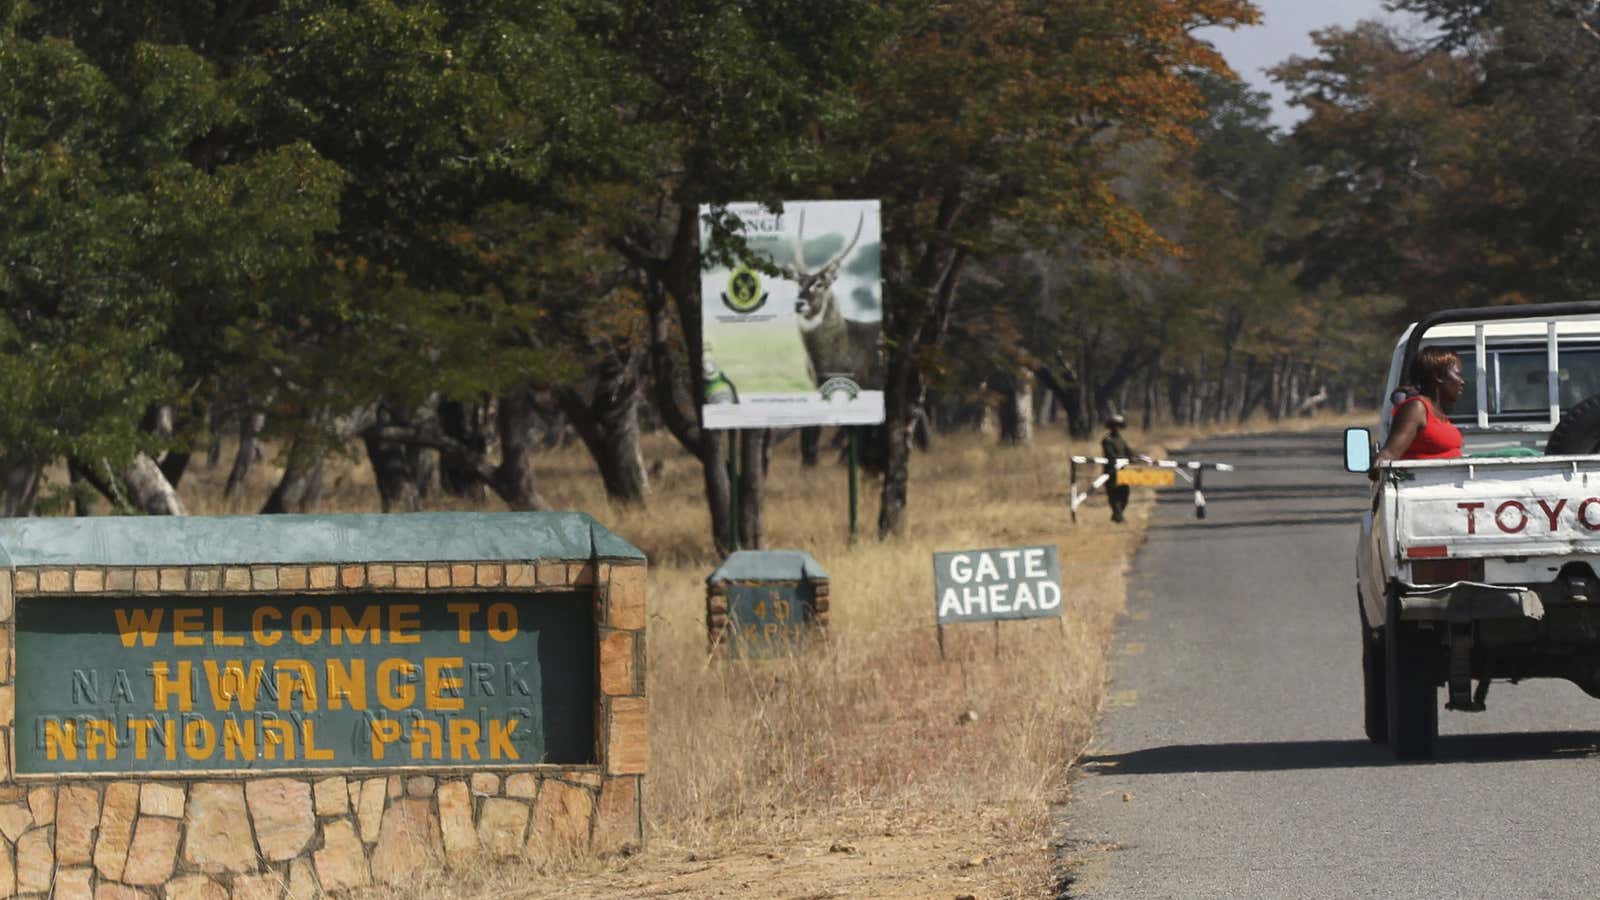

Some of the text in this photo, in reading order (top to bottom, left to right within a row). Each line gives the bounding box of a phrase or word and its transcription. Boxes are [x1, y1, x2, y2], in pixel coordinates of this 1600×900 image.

[1457, 498, 1600, 534] TOYO
[950, 549, 1047, 584] GATE
[939, 581, 1061, 617] AHEAD
[115, 602, 520, 648] WELCOME TO
[152, 656, 465, 712] HWANGE
[45, 719, 521, 761] NATIONAL PARK
